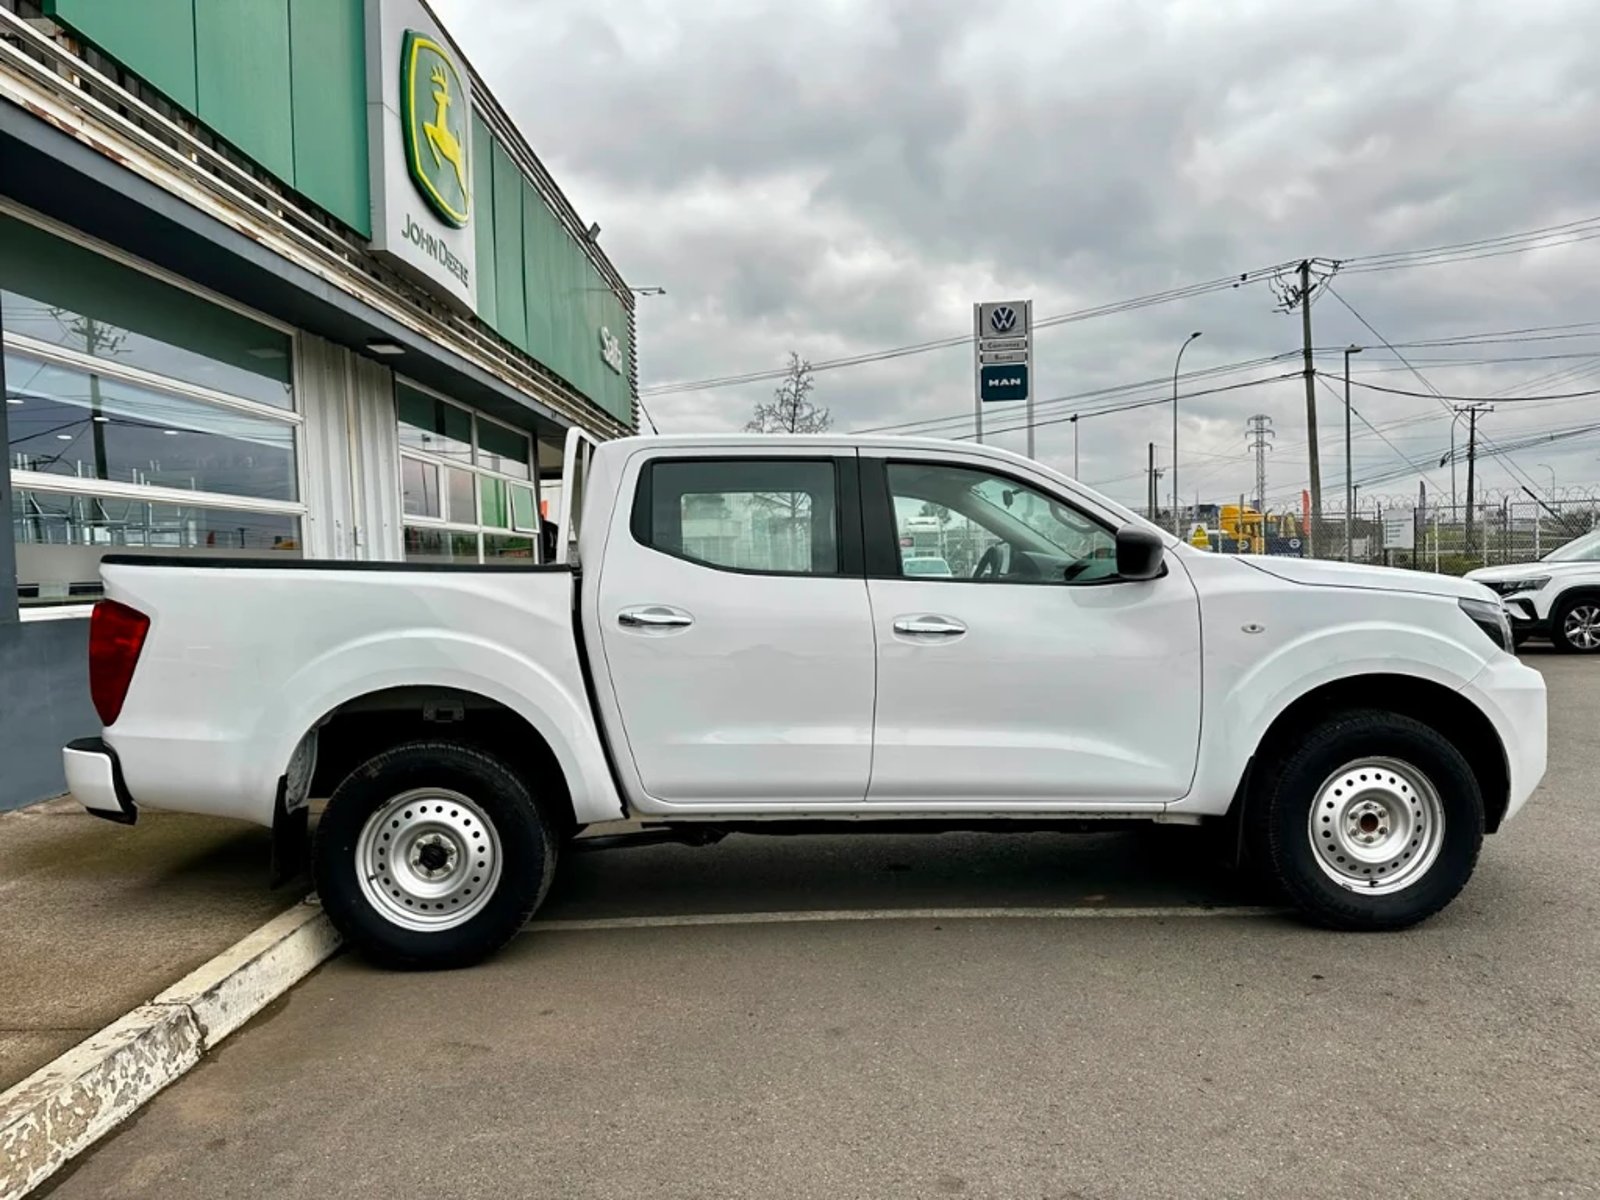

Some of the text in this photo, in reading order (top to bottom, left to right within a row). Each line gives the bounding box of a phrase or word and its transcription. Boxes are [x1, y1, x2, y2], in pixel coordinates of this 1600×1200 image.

[401, 213, 469, 289] JOHN DEERE
[988, 378, 1021, 387] MAN
